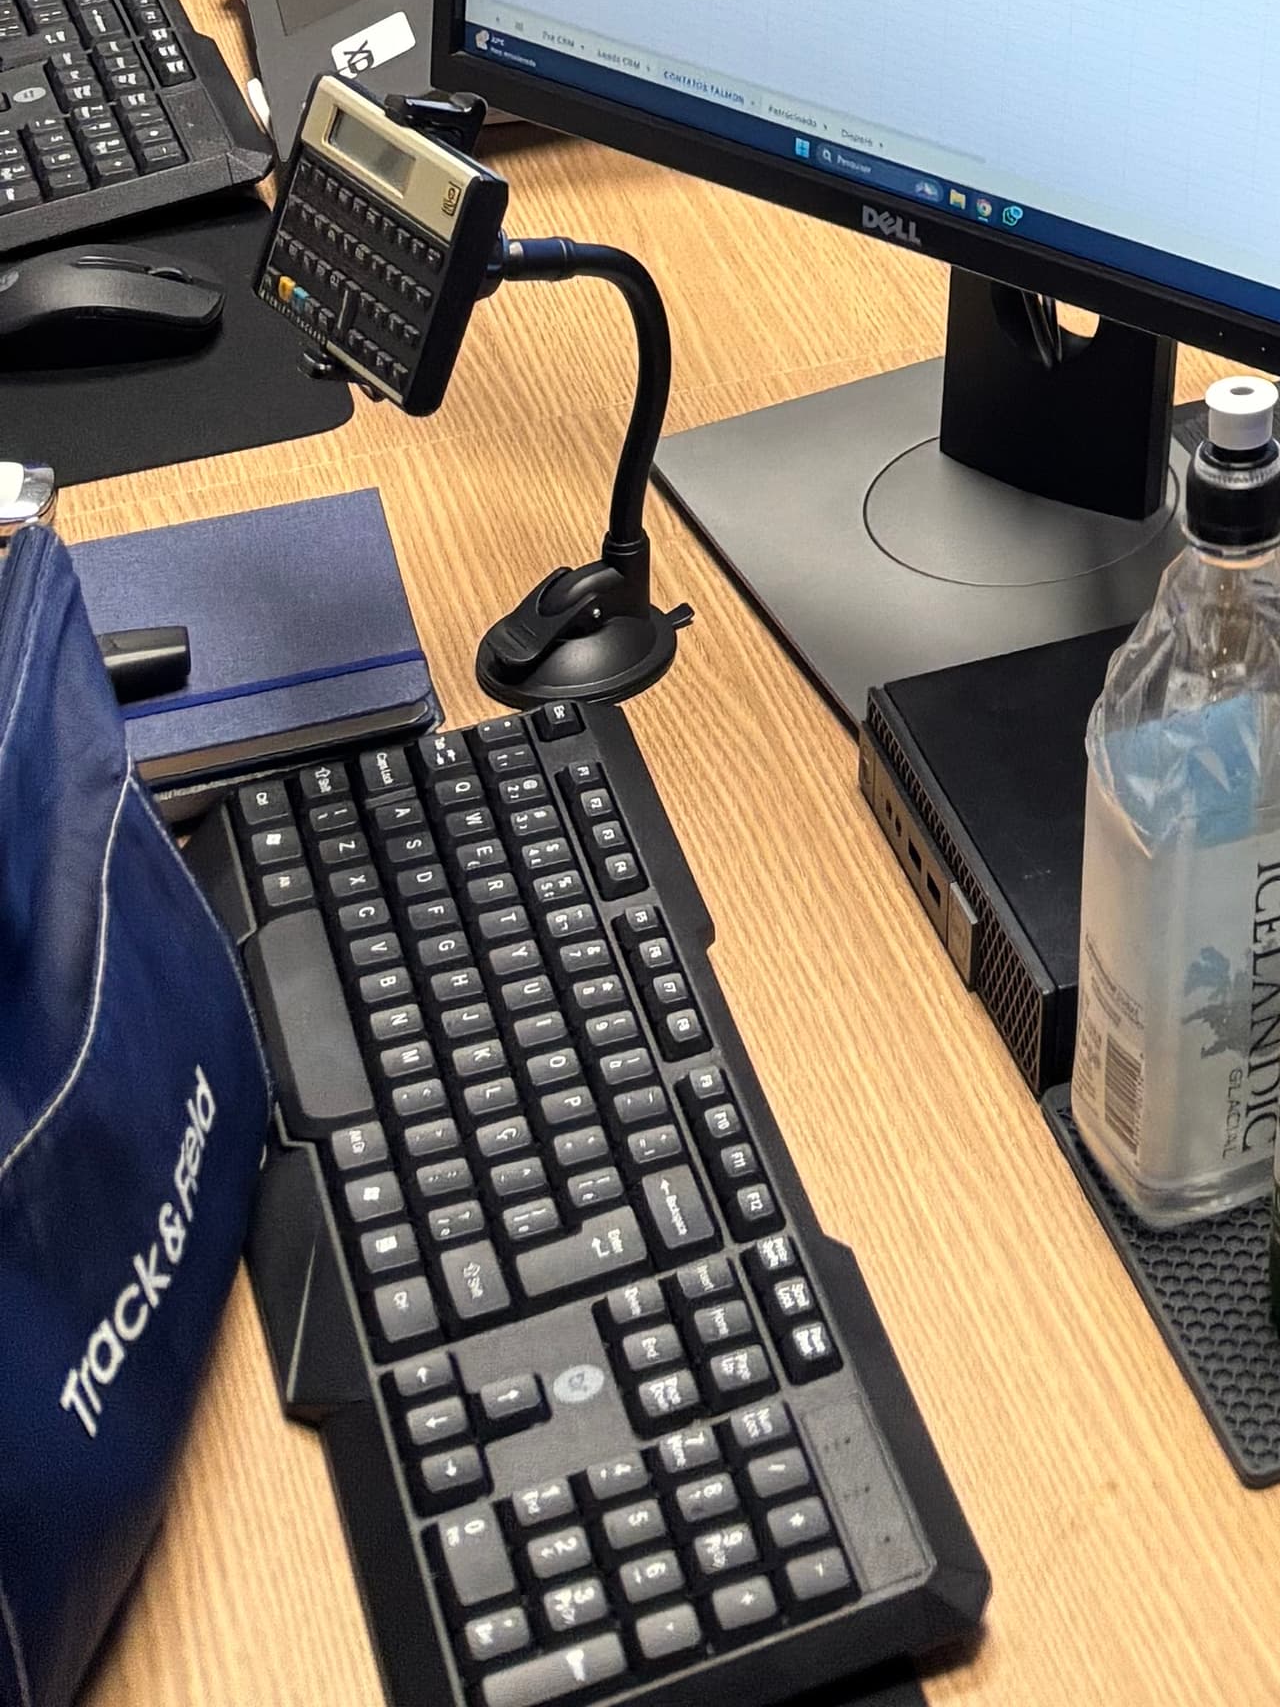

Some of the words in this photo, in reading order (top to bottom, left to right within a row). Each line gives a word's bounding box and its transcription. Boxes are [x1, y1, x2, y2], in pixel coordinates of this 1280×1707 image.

[862, 205, 922, 246] DELL
[456, 782, 471, 793] Q
[395, 808, 411, 818] A
[466, 813, 483, 826] W
[406, 839, 422, 850] S
[476, 845, 493, 857] E
[350, 874, 366, 886] X
[416, 871, 433, 883] D
[487, 881, 504, 892] R
[358, 906, 375, 918] C
[427, 905, 445, 916] F
[500, 912, 517, 923] T
[370, 941, 387, 953] V
[438, 940, 455, 952] G
[511, 946, 528, 958] Y
[379, 975, 396, 987] B
[451, 973, 469, 987] H
[523, 982, 541, 994] U
[390, 1012, 408, 1026] N
[462, 1012, 480, 1022] J
[401, 1048, 420, 1063] M
[473, 1047, 491, 1061] K
[485, 1085, 502, 1099] L
[564, 1095, 581, 1107] P
[1221, 1067, 1243, 1159] GLACIAL
[628, 1509, 650, 1527] 5
